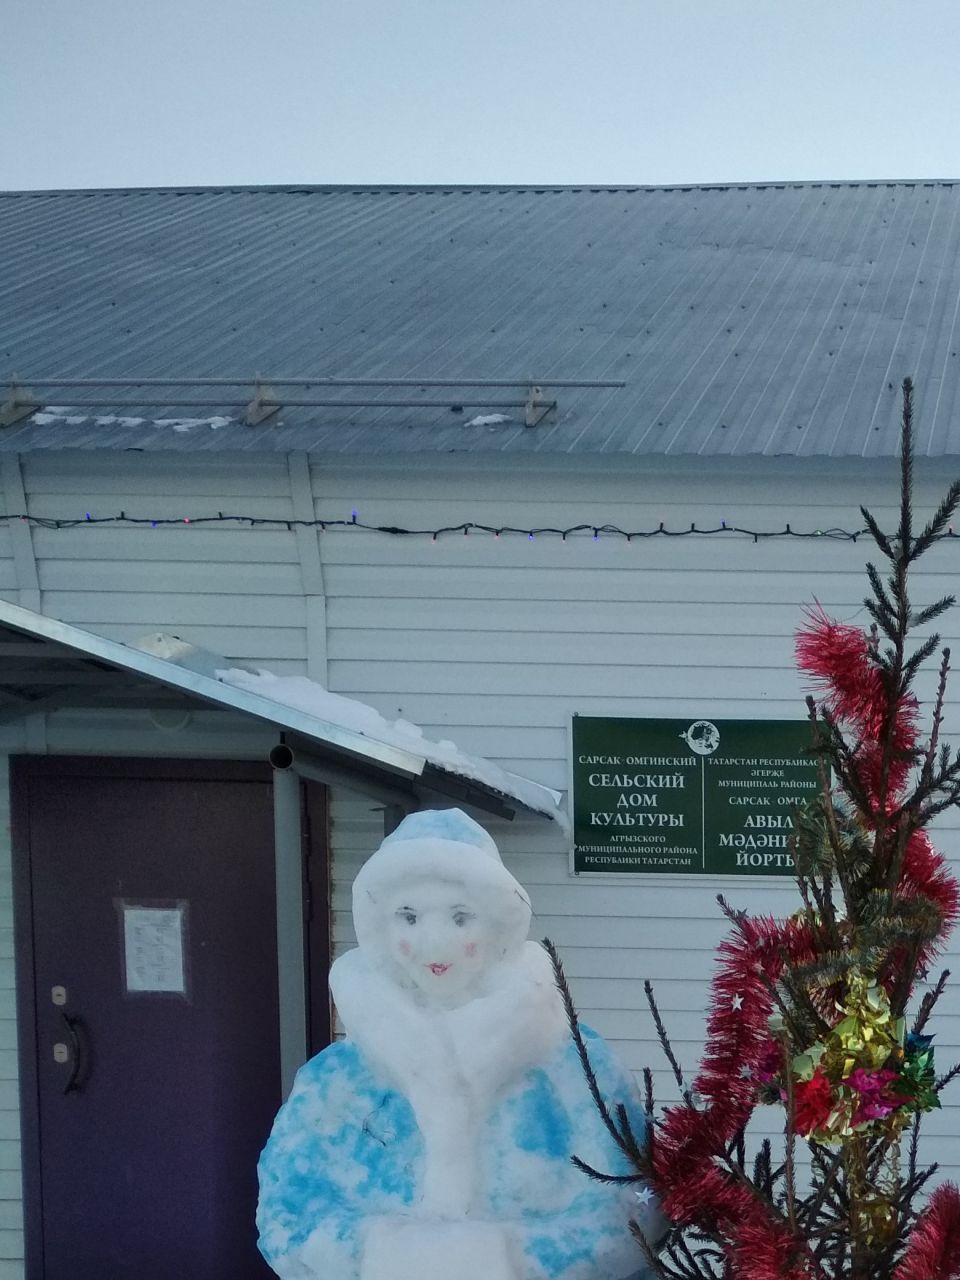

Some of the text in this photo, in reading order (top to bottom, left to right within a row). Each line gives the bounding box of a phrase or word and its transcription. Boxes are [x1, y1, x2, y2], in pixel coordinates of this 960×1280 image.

[578, 755, 621, 765] САРСАК
[626, 755, 697, 766] ОМГИНСКИЙ
[708, 757, 757, 766] ТАТАРСТАН
[588, 771, 685, 788] СЕЛЬСКИЙ
[718, 779, 817, 789] МУНИЦИПАЛЬ РАЙОНЫ
[616, 793, 658, 809] ДОМ
[728, 796, 771, 806] САРСАК
[777, 796, 808, 806] ОМГА
[590, 812, 685, 827] КУЛЬТУРЫ
[743, 815, 794, 828] АВЫЛ
[609, 835, 667, 843] АГРЫЗСКОГО
[578, 845, 698, 855] МУНИЦИПАЛЬНОГО РАЙОНА
[584, 856, 692, 866] РЕСПУБЛИКИ ТАТАРСТАН
